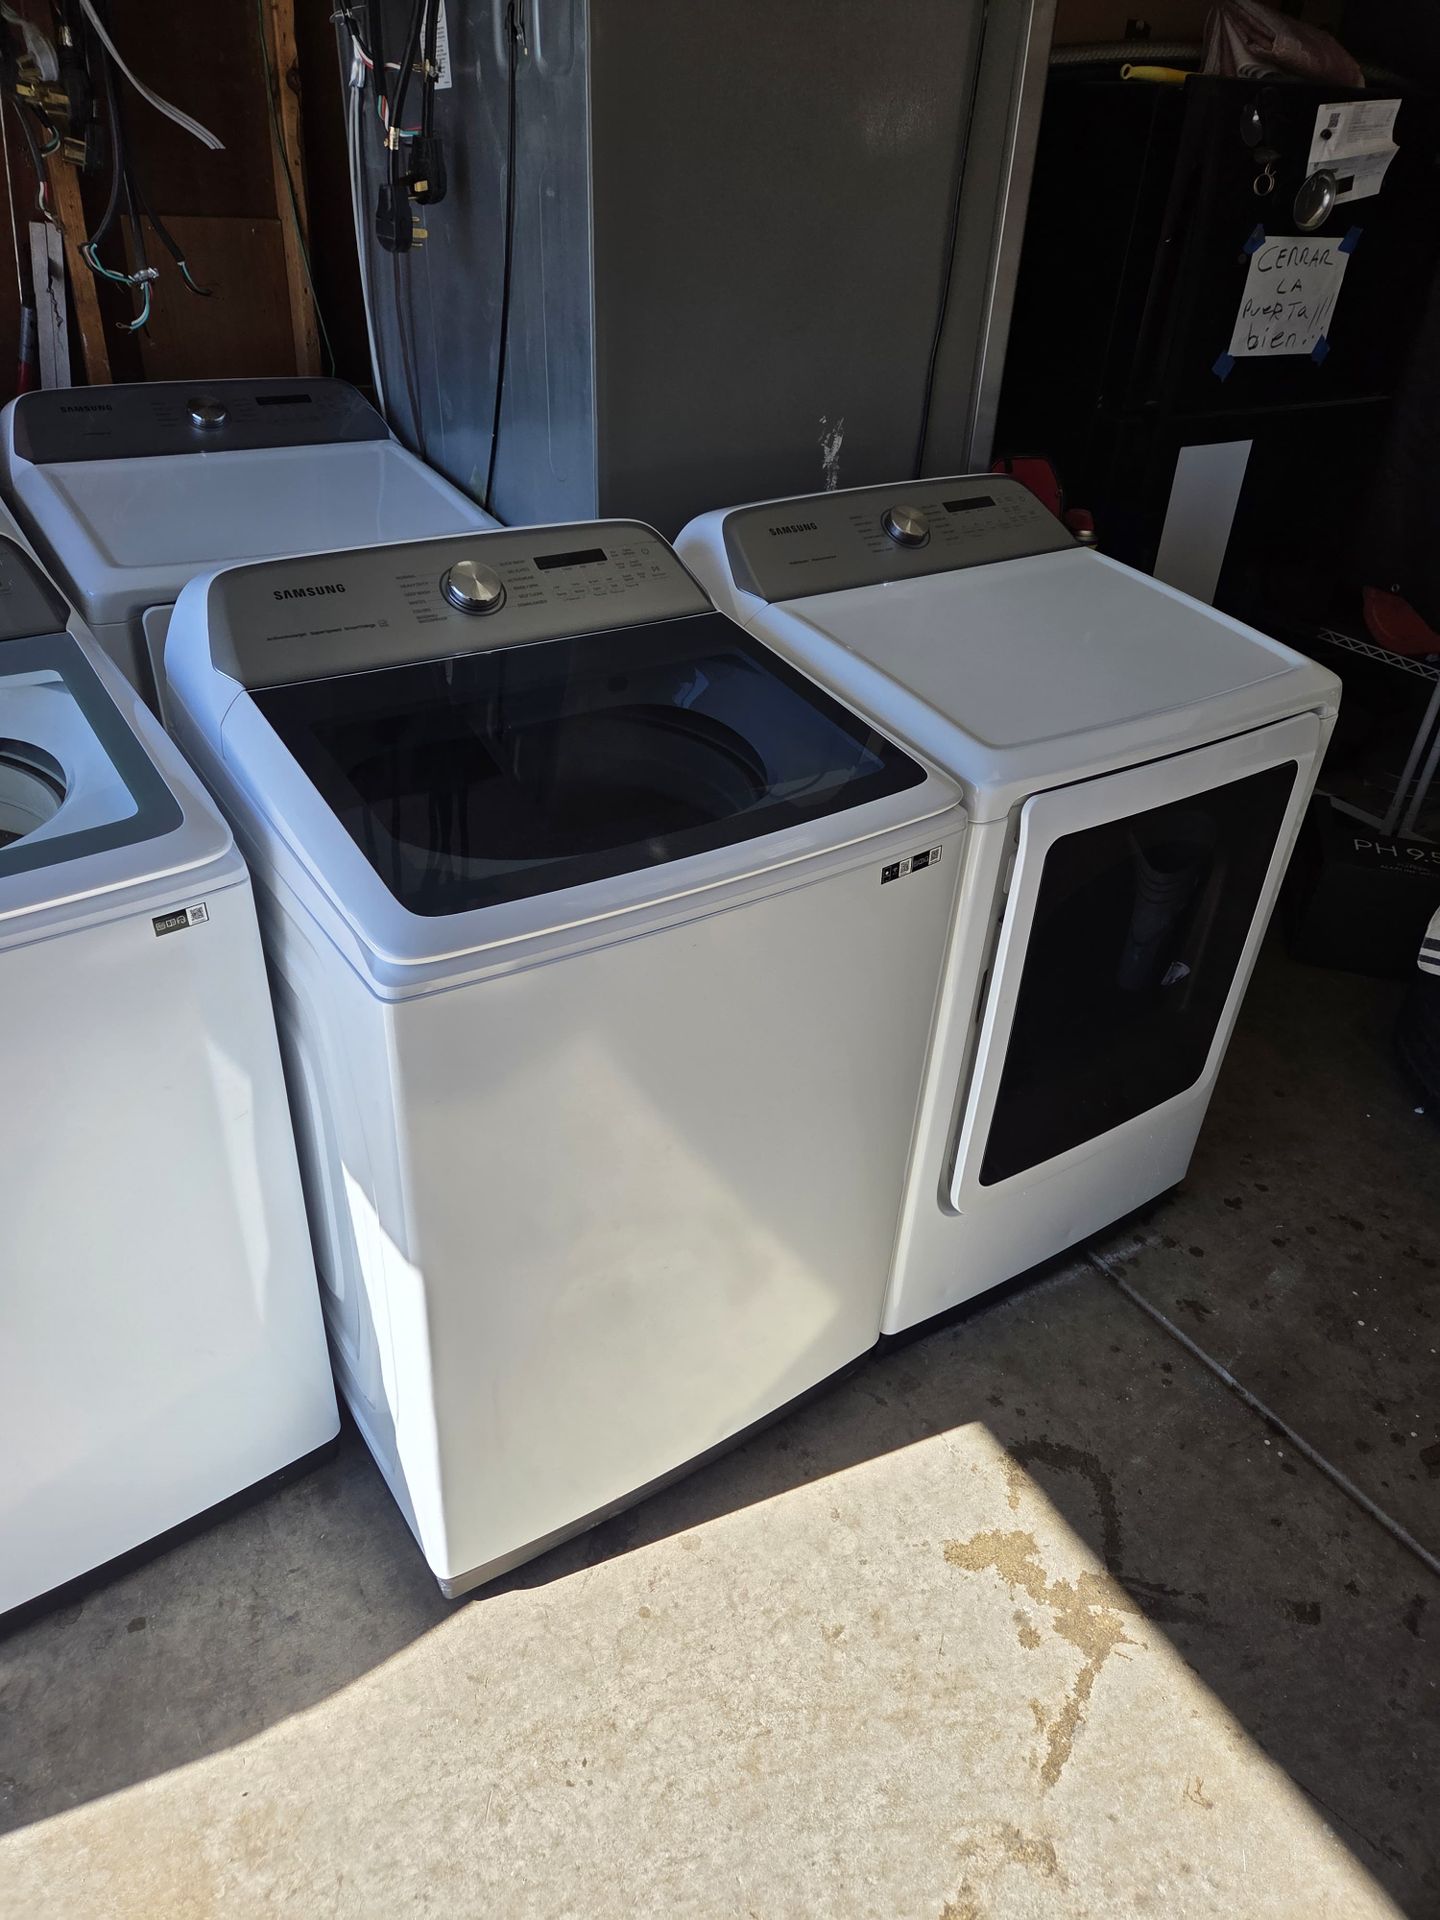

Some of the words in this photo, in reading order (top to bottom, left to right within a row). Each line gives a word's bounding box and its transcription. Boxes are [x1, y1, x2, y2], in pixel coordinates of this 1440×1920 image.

[1257, 245, 1334, 272] CERRAR
[1276, 279, 1303, 294] LA
[59, 403, 113, 414] SAMSUNG
[768, 522, 818, 536] SAMSUNG
[273, 583, 346, 601] SAMSUNG
[1354, 838, 1398, 857] PH
